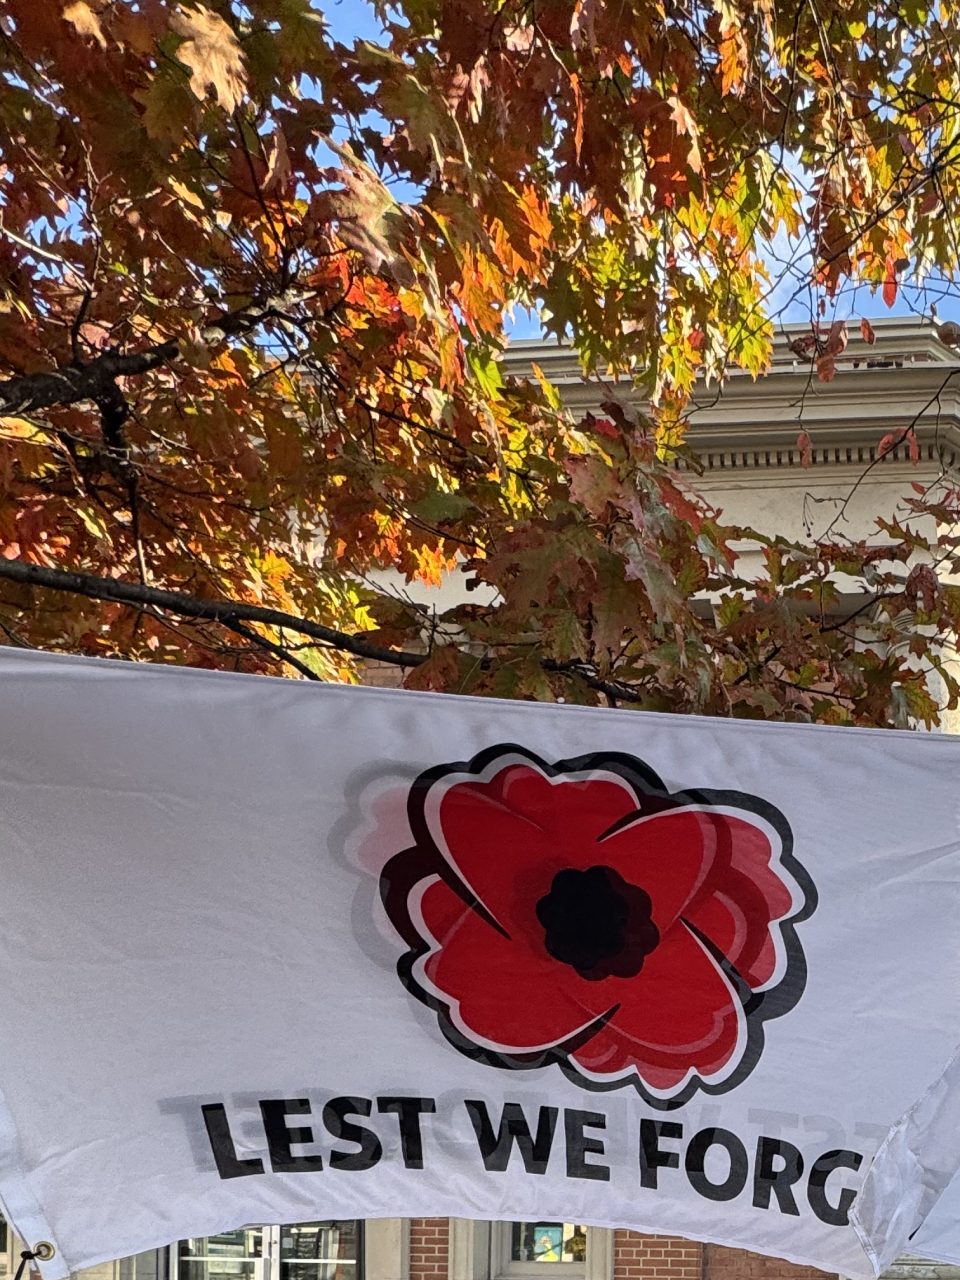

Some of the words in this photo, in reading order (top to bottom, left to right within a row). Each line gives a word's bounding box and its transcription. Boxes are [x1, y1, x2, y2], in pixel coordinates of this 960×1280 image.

[201, 1096, 437, 1180] LEST
[464, 1099, 611, 1182] WE
[640, 1118, 865, 1227] FORG
